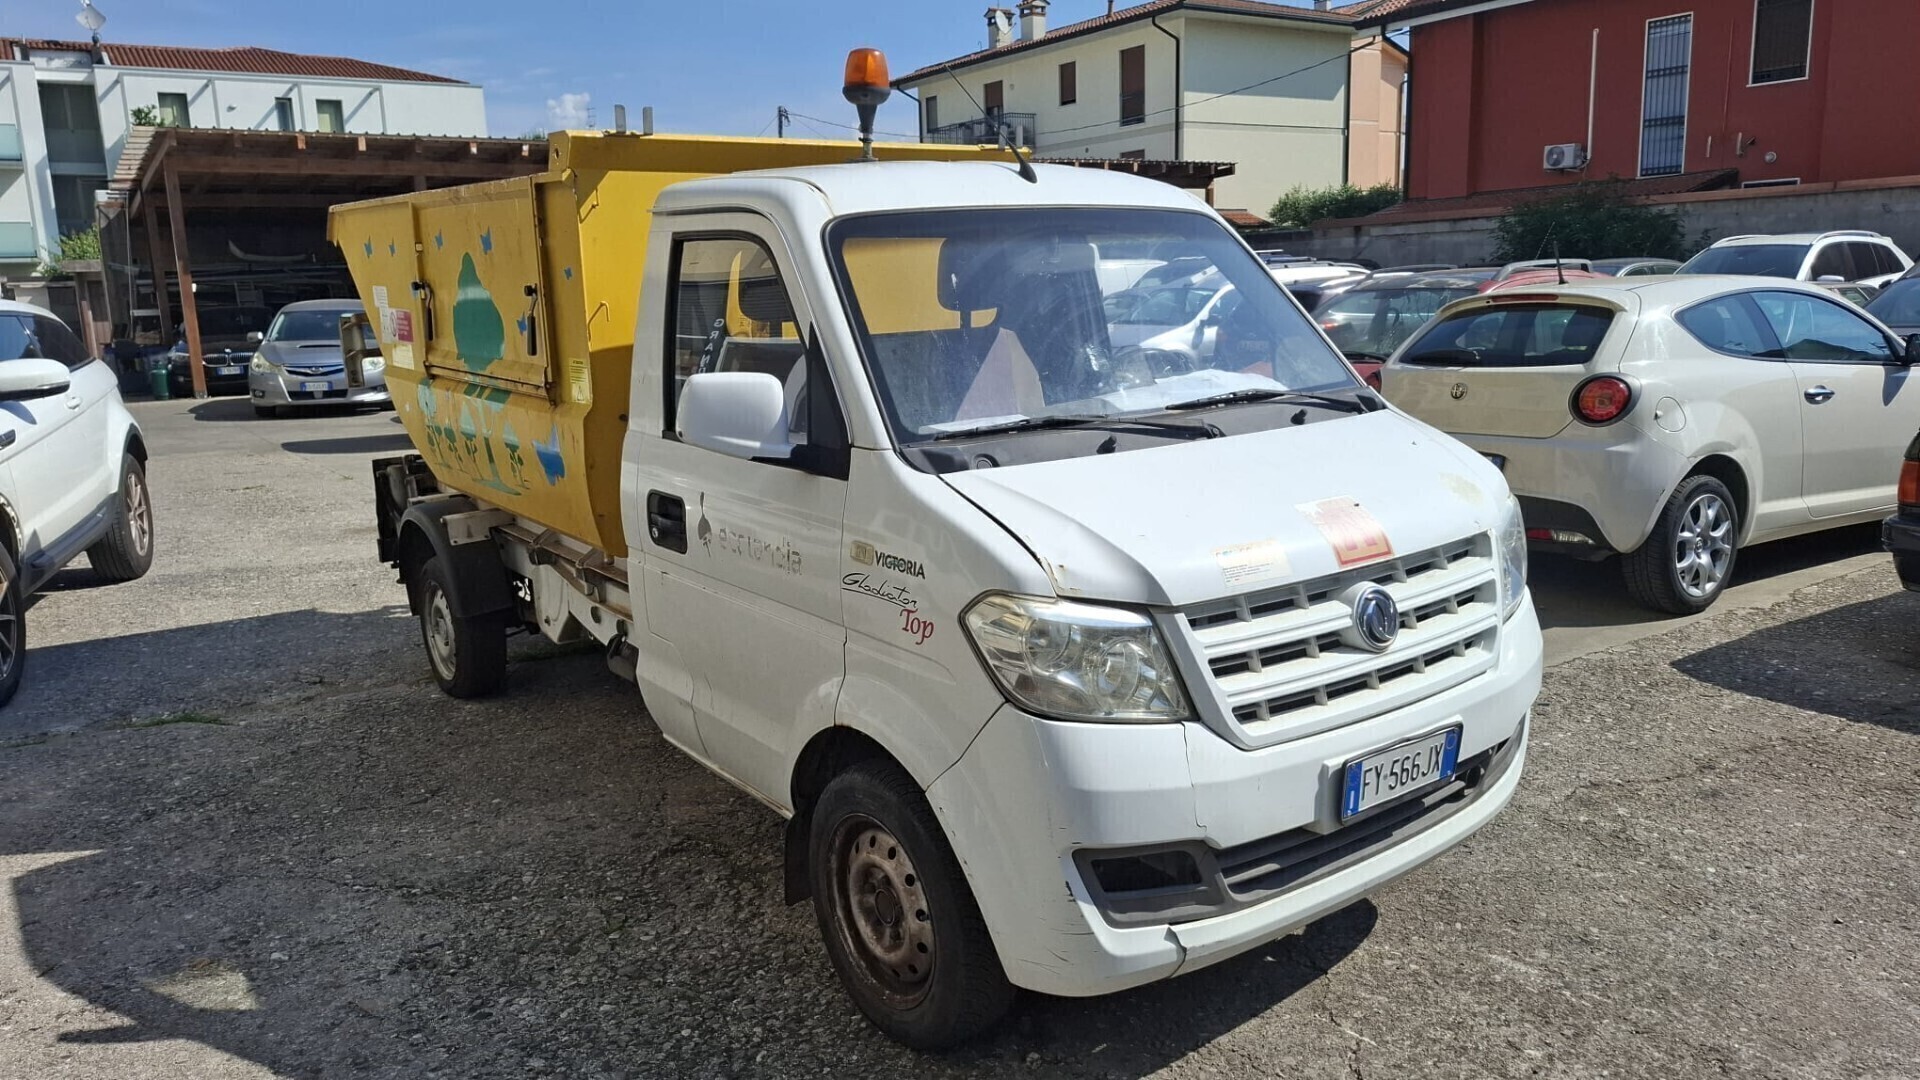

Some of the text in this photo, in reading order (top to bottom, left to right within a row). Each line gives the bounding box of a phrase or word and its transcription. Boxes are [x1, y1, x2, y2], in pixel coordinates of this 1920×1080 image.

[875, 550, 926, 580] VICTORIA
[842, 572, 918, 608] Gladiator
[899, 608, 935, 645] Top
